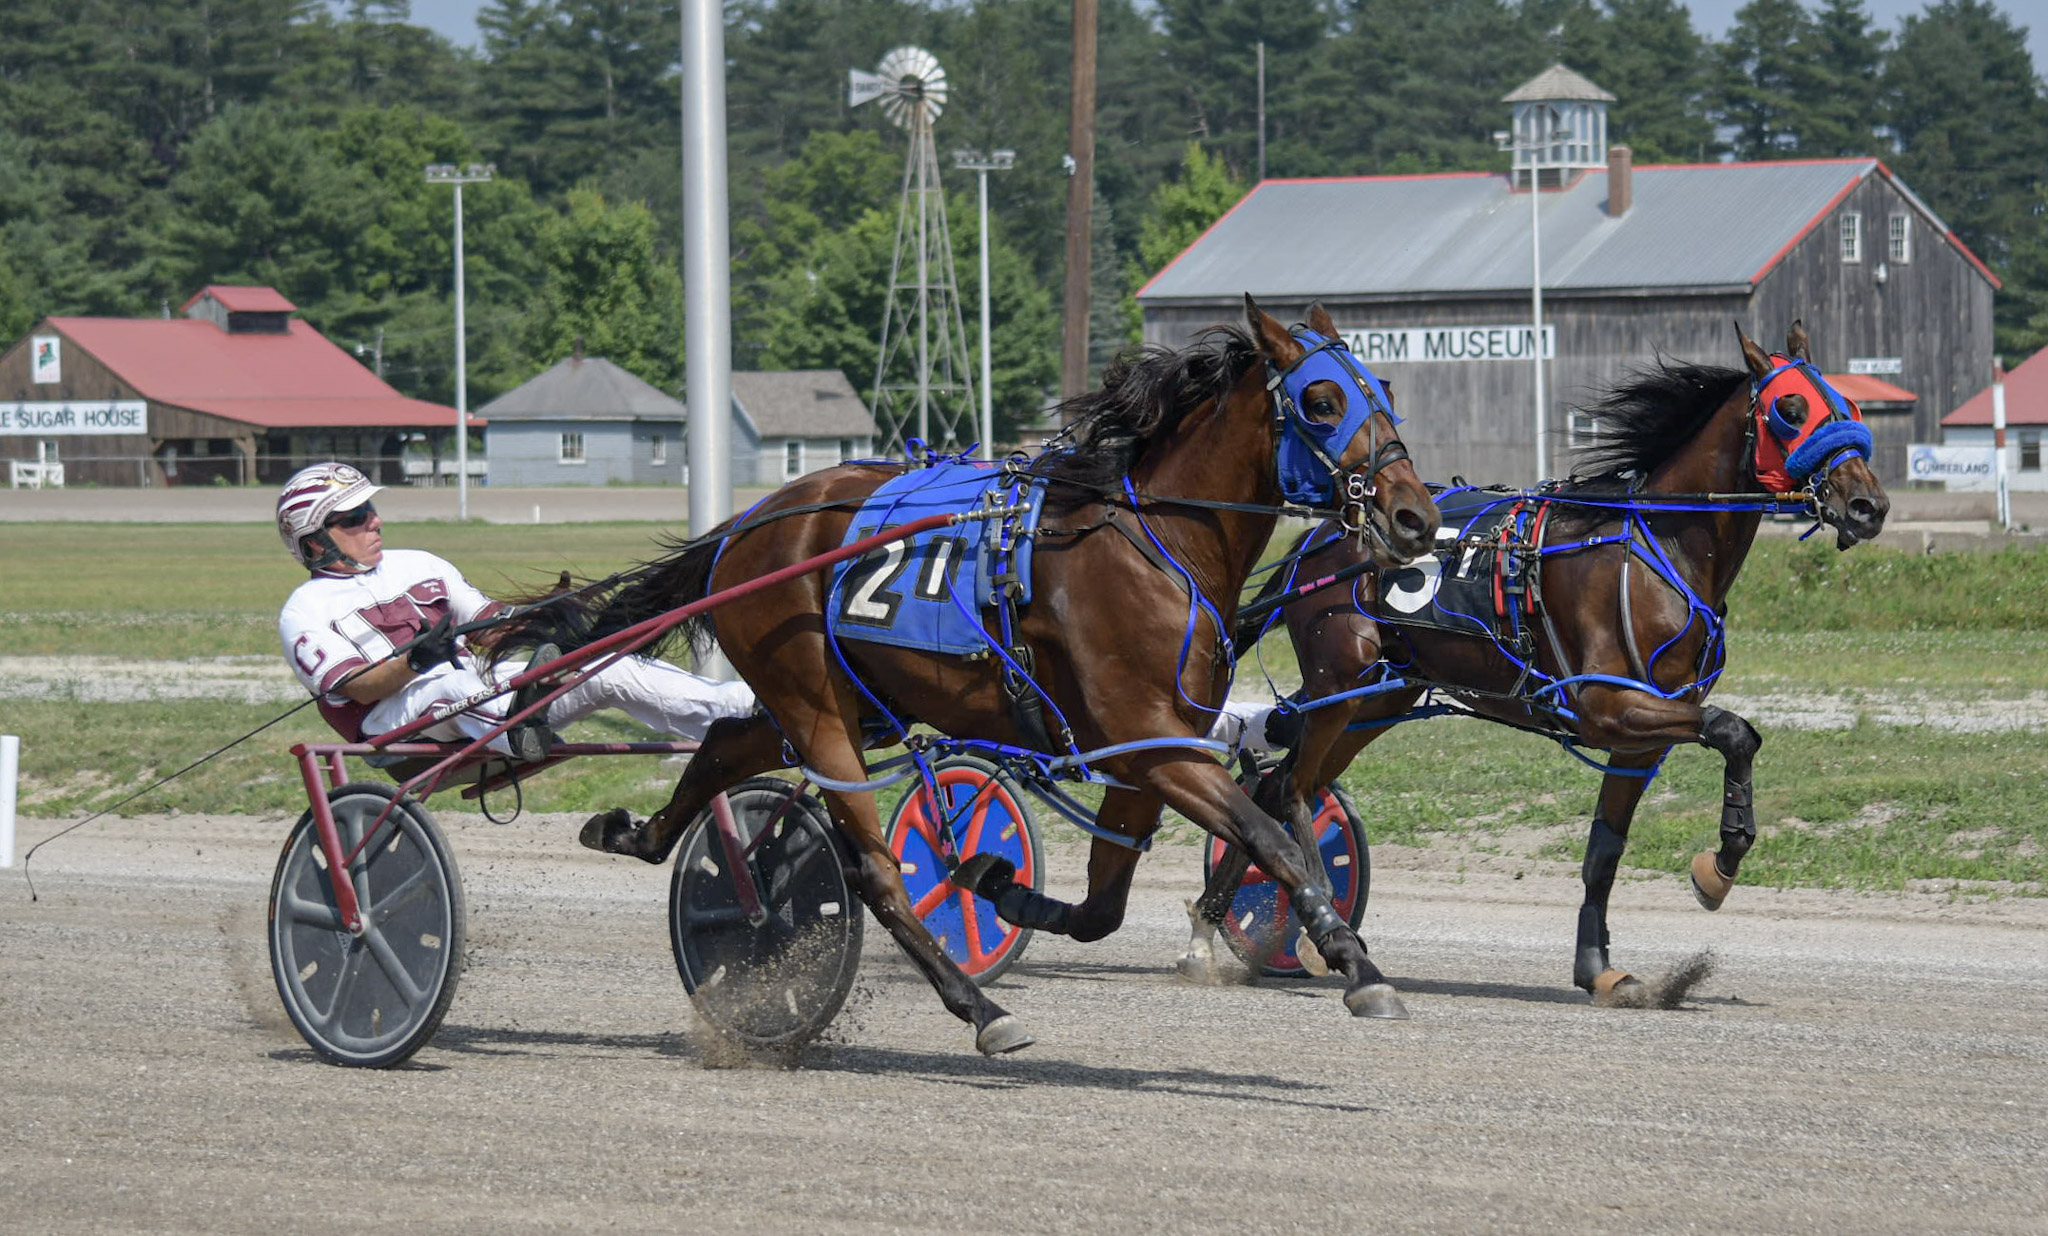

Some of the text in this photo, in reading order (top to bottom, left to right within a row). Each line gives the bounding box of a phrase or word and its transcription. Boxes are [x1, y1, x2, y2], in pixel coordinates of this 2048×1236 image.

[1340, 329, 1548, 359] ARM MUSEUM
[0, 409, 140, 428] E SUGAR HOUSE
[433, 698, 469, 720] WALTER
[471, 685, 498, 705] CASE
